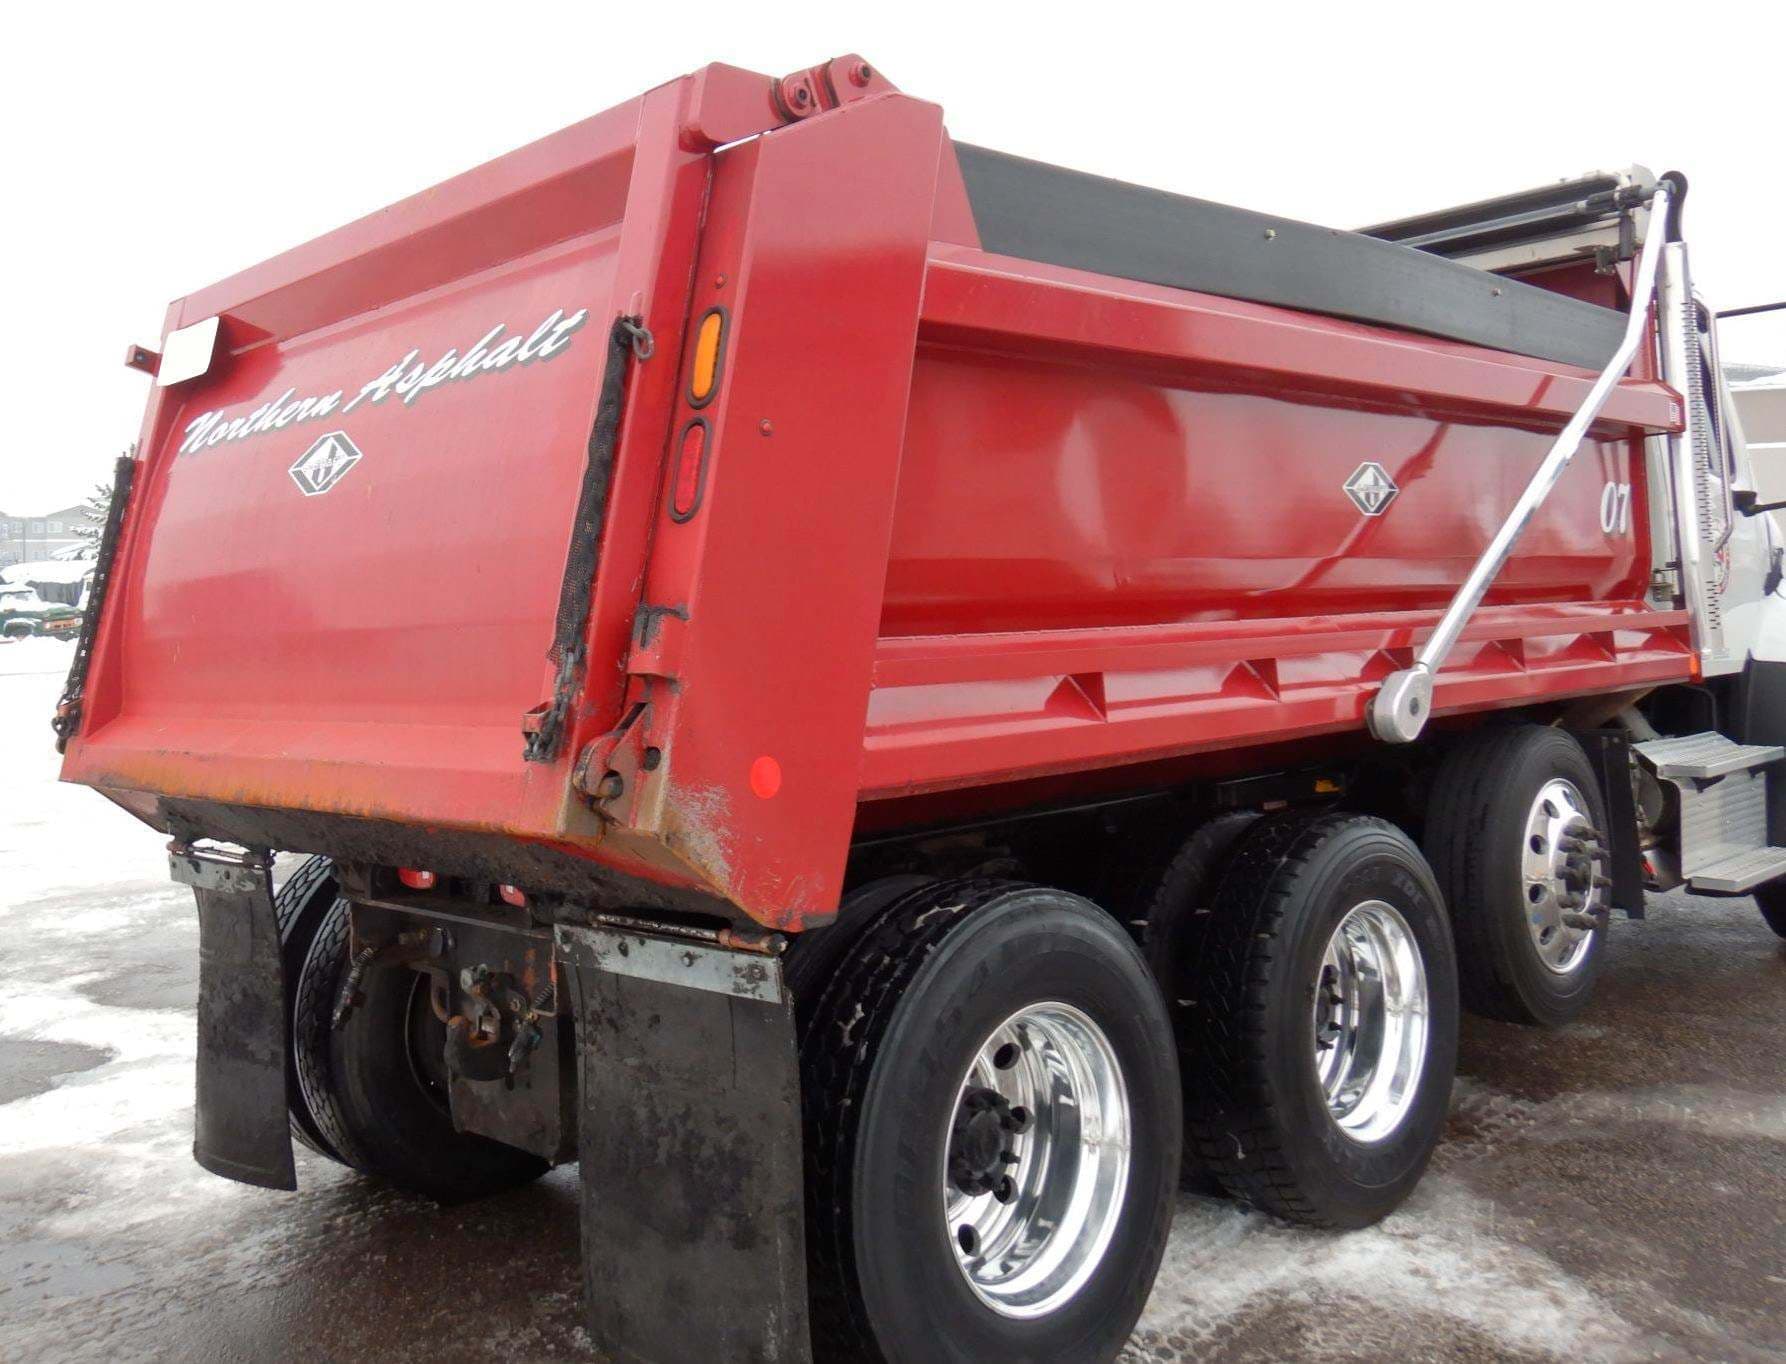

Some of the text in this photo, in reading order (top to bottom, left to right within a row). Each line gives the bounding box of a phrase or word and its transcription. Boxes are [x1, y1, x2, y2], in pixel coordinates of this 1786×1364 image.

[180, 307, 589, 455] Northern Asphalt
[1601, 480, 1631, 534] 07
